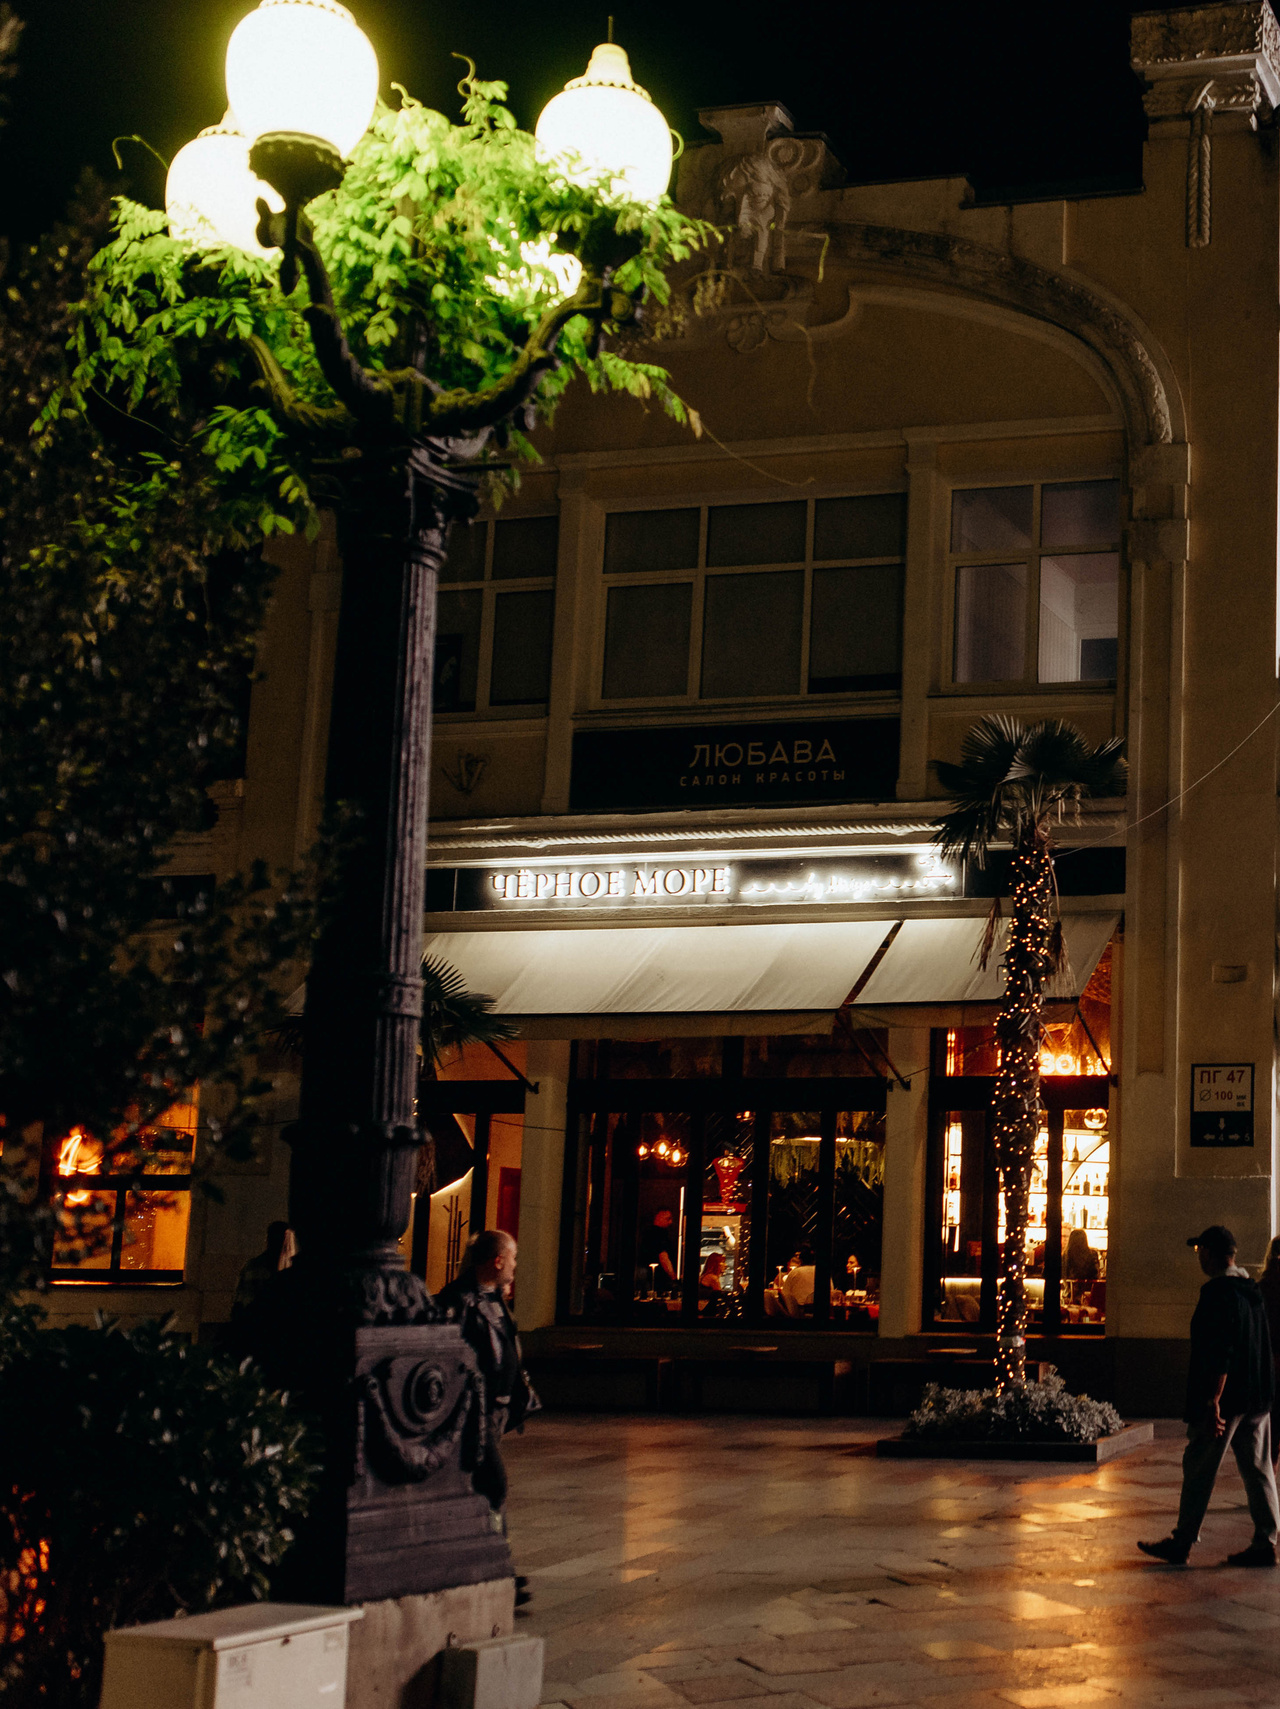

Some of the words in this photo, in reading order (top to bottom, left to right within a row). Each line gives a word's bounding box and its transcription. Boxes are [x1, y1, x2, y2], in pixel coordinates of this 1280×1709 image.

[689, 739, 836, 768] ЛЮБАВА
[680, 774, 741, 787] САЛОН
[756, 770, 845, 784] КРАСОТЫ
[489, 869, 626, 900] ЧЁРНОЕ
[630, 866, 732, 897] МОРЕ
[1200, 1070, 1221, 1084] ПГ
[1226, 1070, 1245, 1083] 47
[1215, 1091, 1233, 1100] 100
